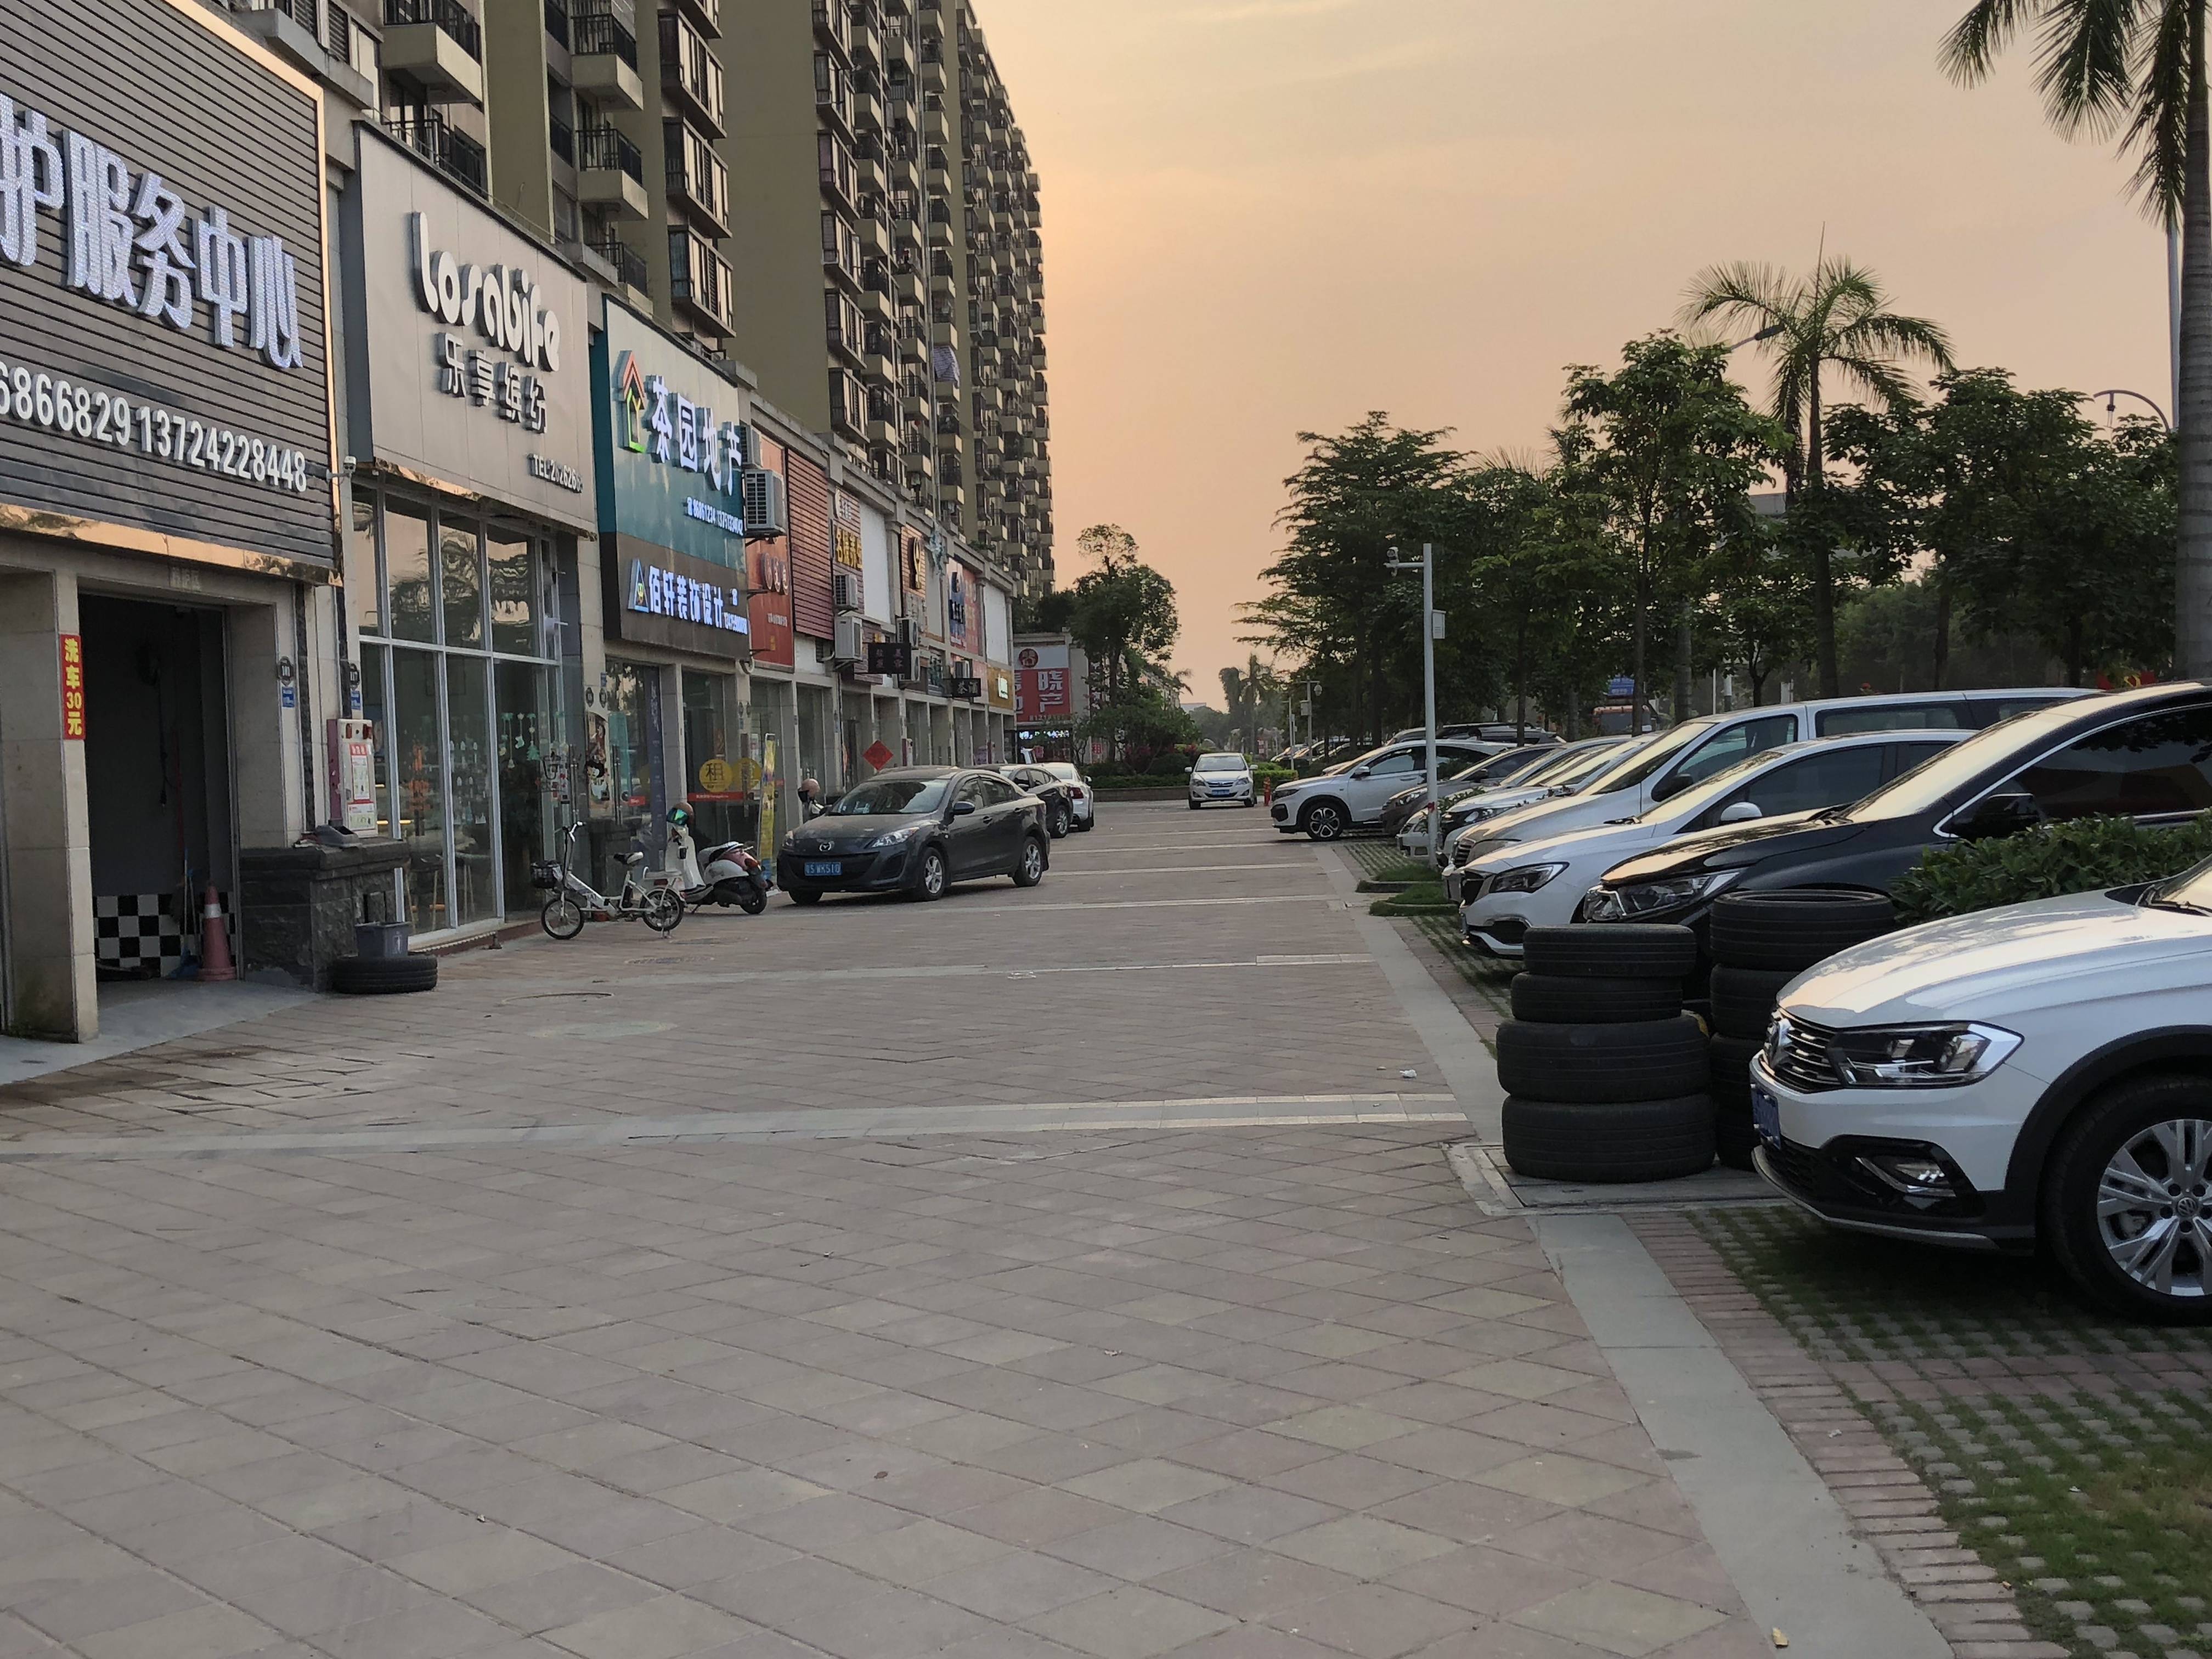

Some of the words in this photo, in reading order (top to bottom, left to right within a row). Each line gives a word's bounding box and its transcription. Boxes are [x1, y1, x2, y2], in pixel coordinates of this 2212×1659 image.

[0, 91, 303, 368] 护服务中心
[442, 333, 548, 433] 乐享缤纷
[137, 406, 307, 493] 13724228448
[652, 375, 741, 496] 茶园地产
[649, 566, 723, 628] 佰轩装饰设计
[706, 763, 724, 780] 租
